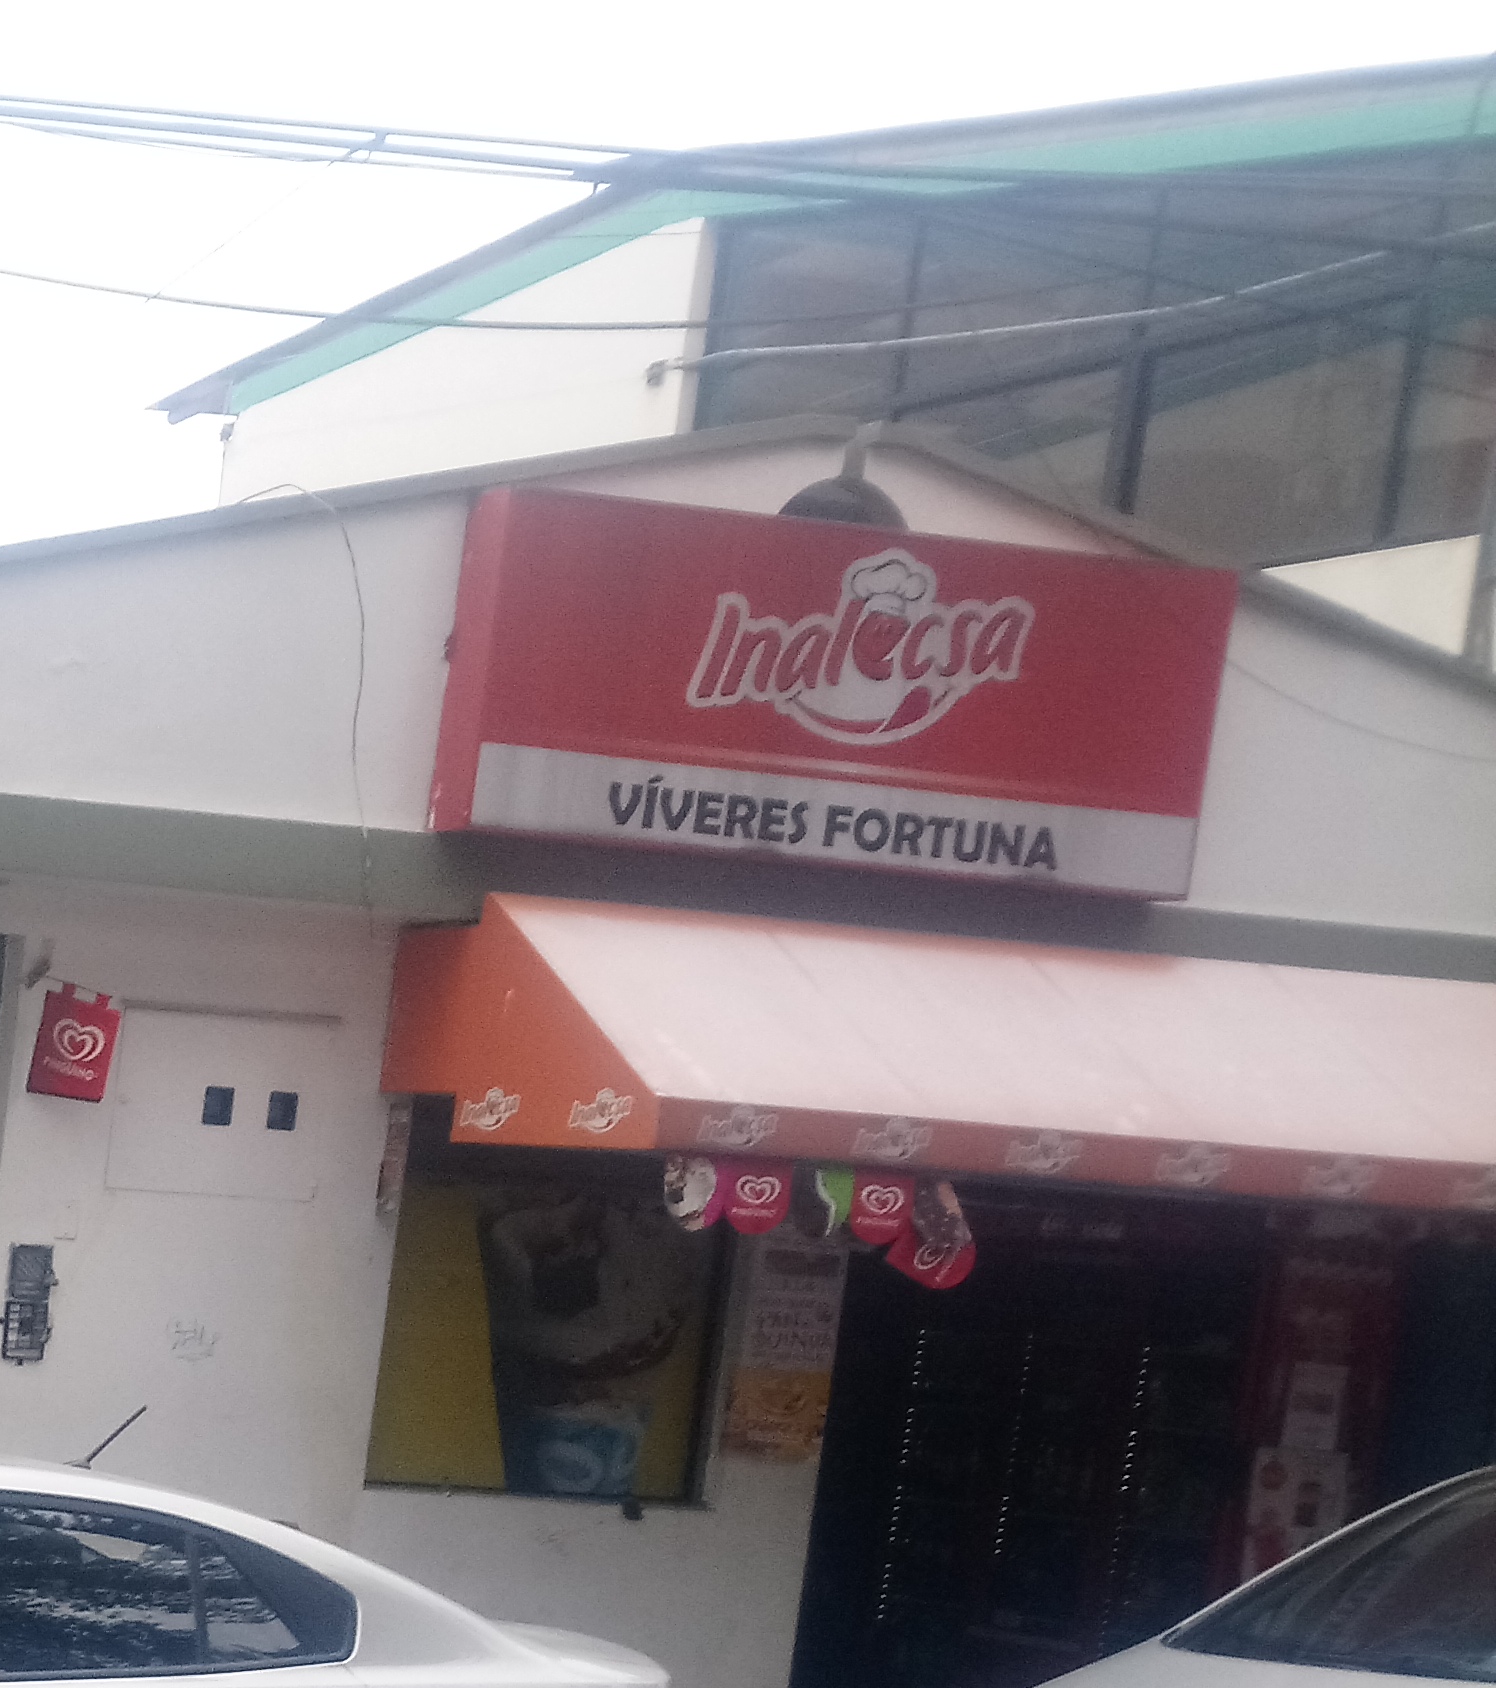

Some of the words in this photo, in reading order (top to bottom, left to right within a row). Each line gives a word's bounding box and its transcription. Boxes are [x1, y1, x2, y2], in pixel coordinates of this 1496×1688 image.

[692, 592, 1034, 706] Inalecsa
[608, 775, 806, 847] VÍVERES
[822, 805, 1059, 872] FORTUNA
